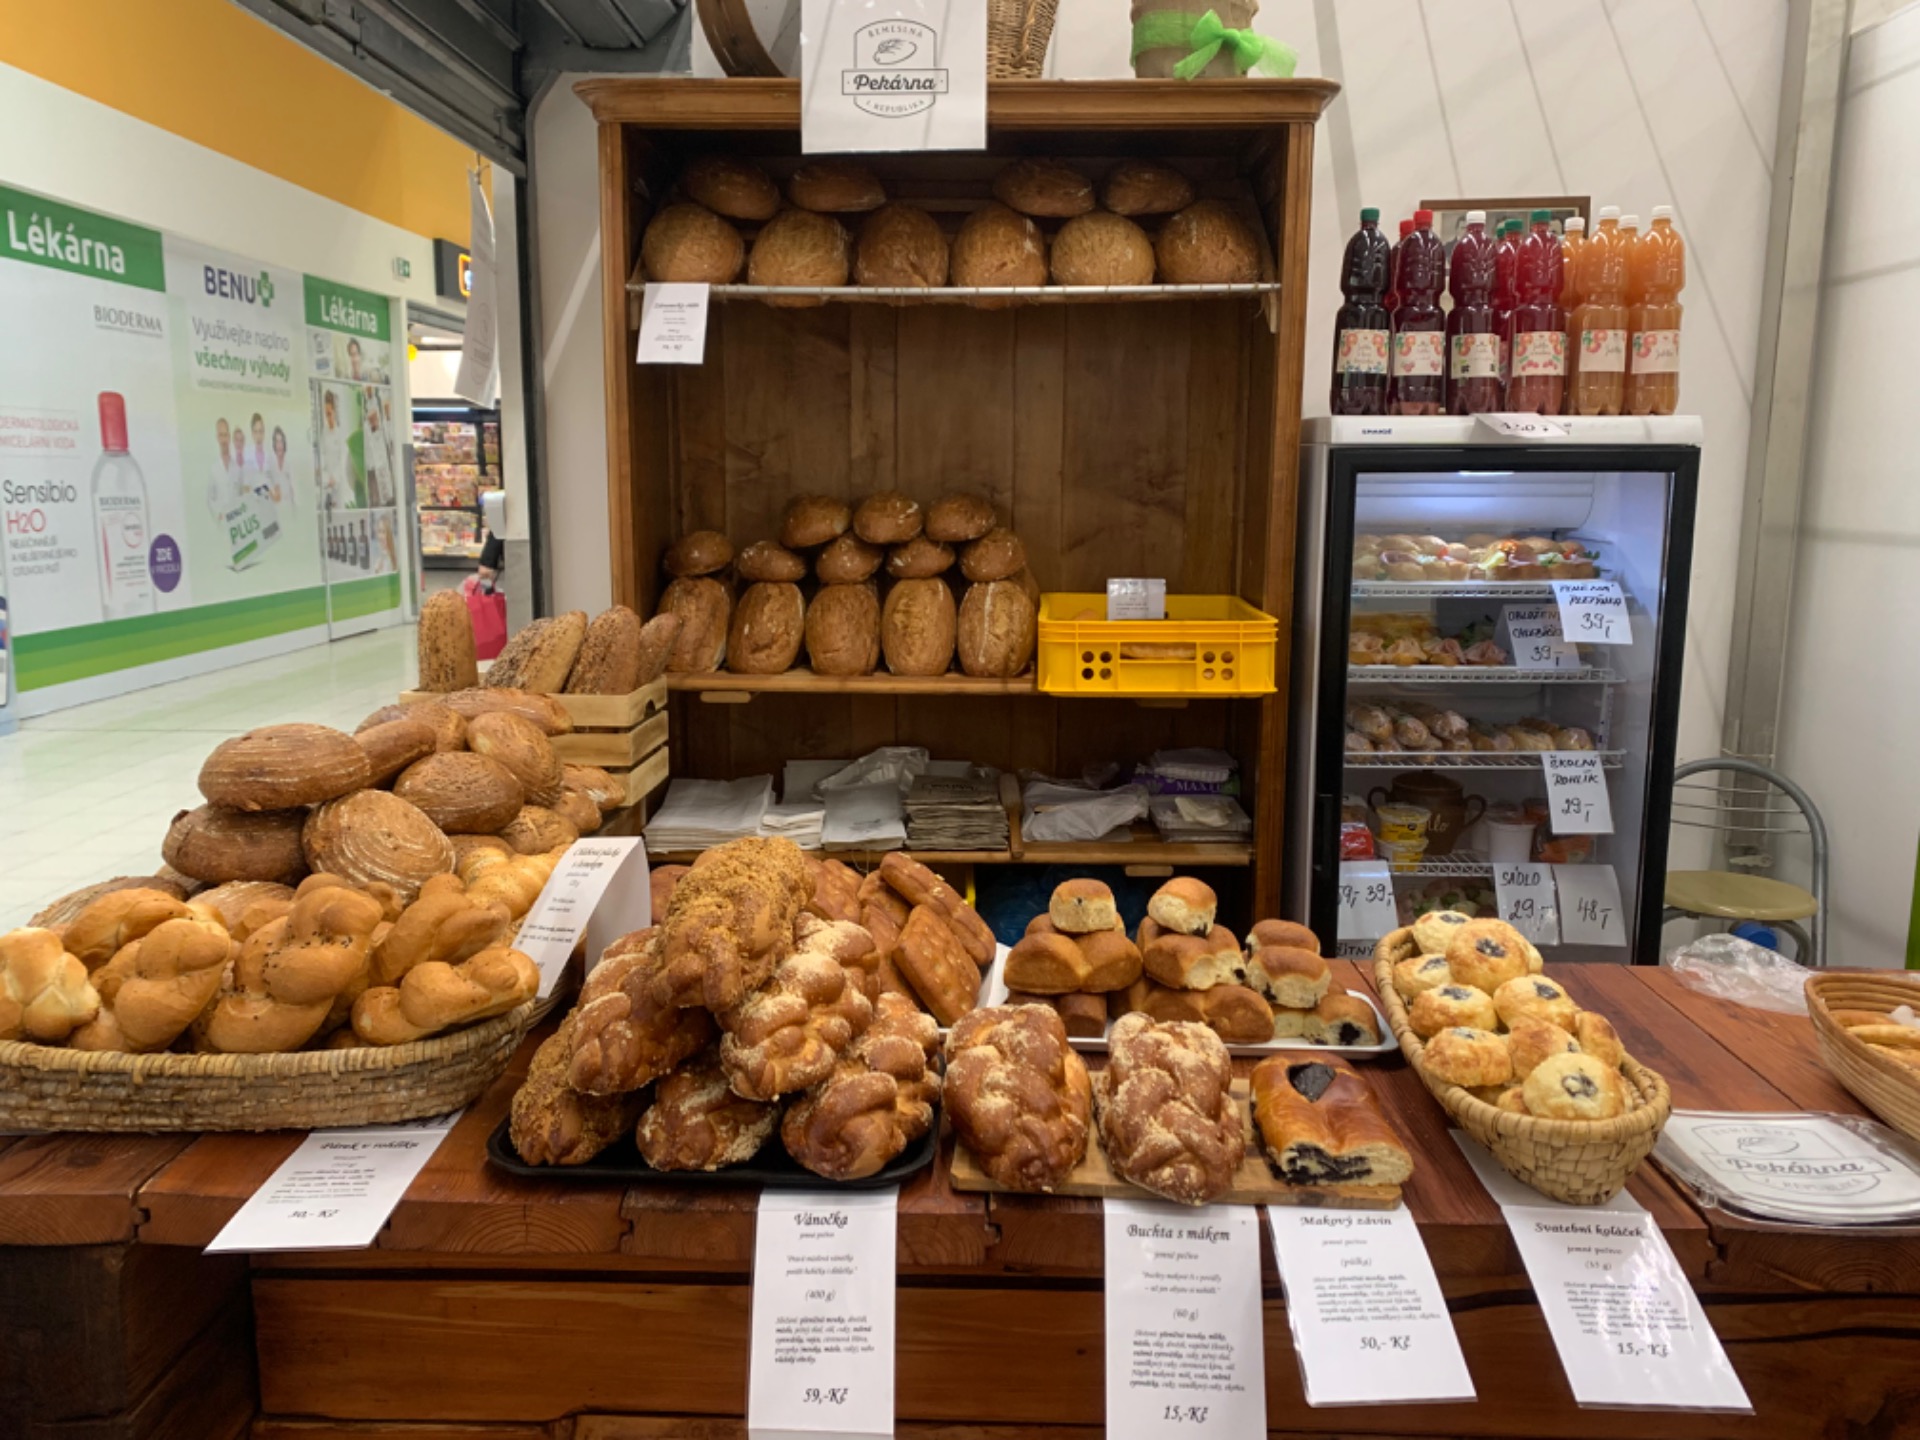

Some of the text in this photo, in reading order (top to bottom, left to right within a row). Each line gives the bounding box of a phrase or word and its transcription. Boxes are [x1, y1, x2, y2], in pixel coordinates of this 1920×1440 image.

[853, 73, 937, 91] Pekárna
[8, 210, 125, 274] Lékárna
[204, 264, 257, 304] BENU
[94, 305, 163, 332] BIODERMA
[320, 294, 378, 333] Lékárna
[192, 316, 252, 347] Využívejte
[254, 331, 289, 351] naplno
[195, 346, 290, 383] všechny výhody
[3, 479, 77, 504] Sensibio
[6, 508, 47, 534] H2O
[229, 513, 260, 545] PLUS
[1500, 866, 1541, 886] SÁDLO
[1726, 1157, 1864, 1176] Pekárna
[793, 1211, 849, 1229] Vánočka
[1300, 1214, 1392, 1229] Makový závin
[1535, 1221, 1649, 1239] Svatební koláček
[1126, 1223, 1231, 1244] Buchta s mákem
[802, 1386, 850, 1405] 59,-Kč
[1163, 1405, 1209, 1424] 15,-Kč
